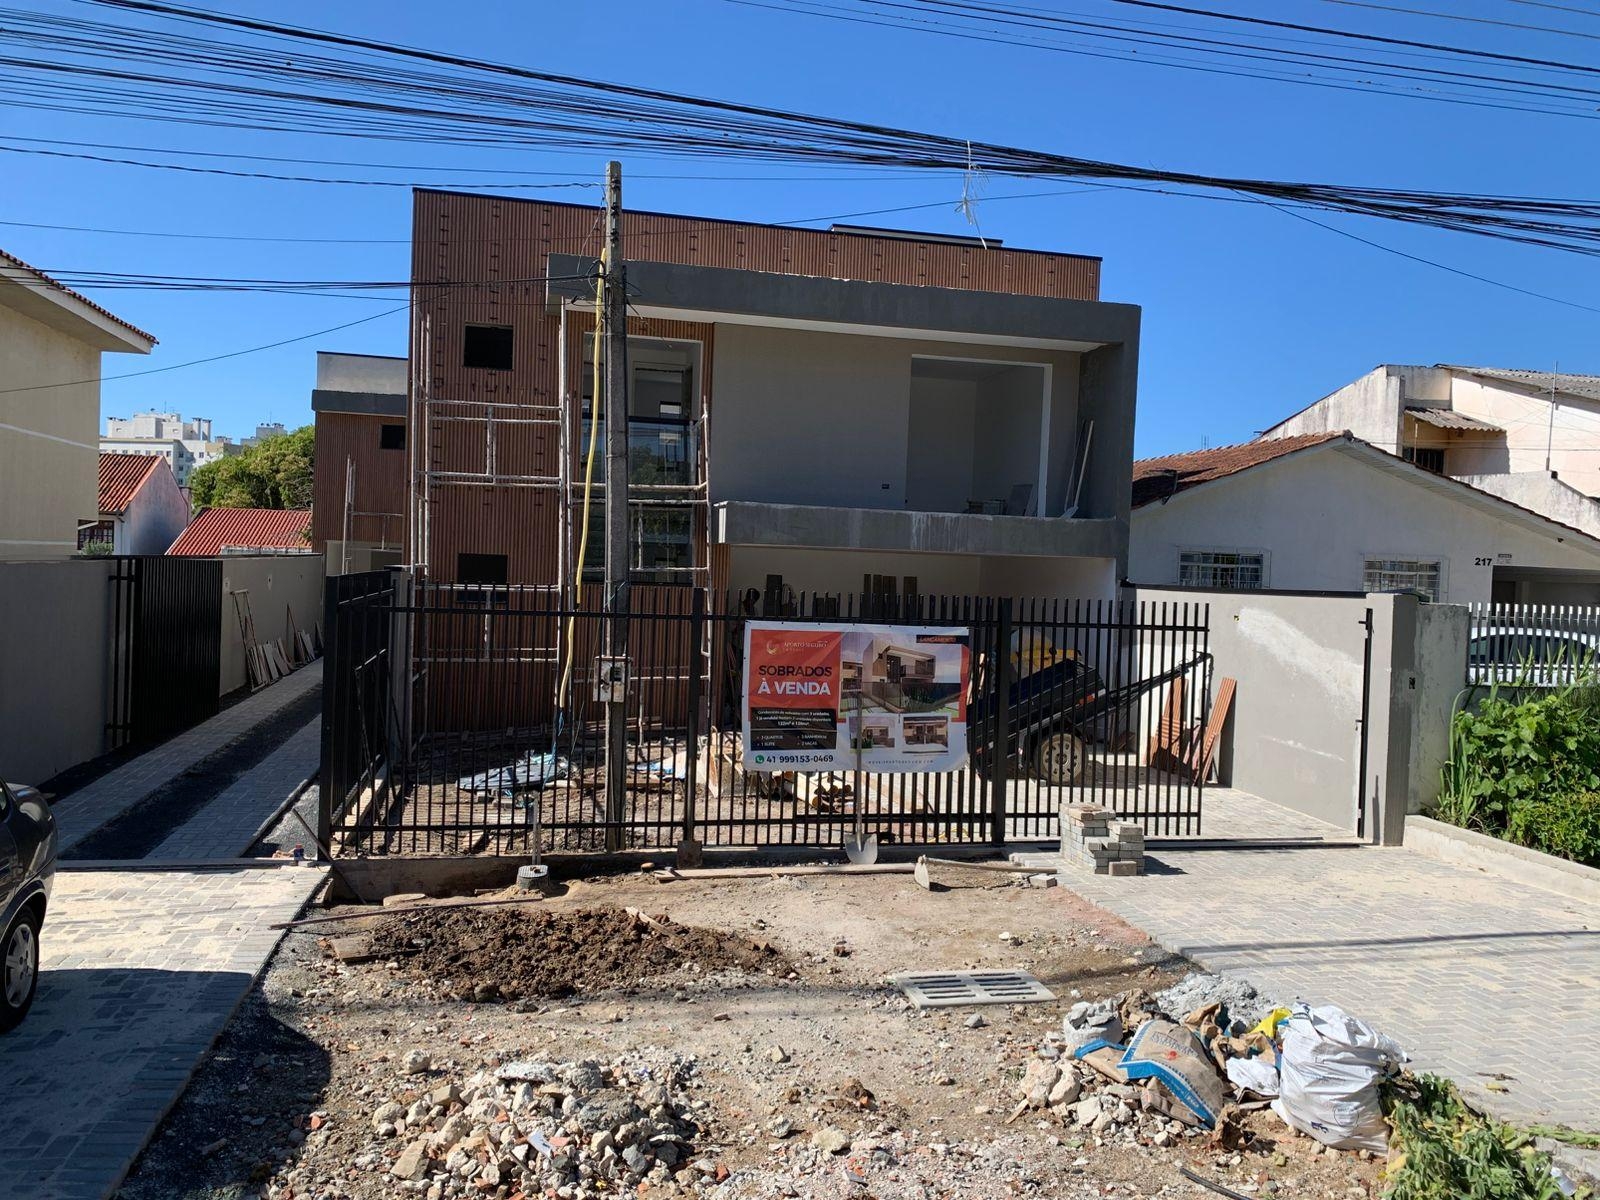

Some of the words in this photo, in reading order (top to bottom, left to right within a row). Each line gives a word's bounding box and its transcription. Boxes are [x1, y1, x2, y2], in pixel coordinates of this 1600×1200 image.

[1474, 557, 1493, 566] 217
[758, 665, 833, 677] SOBRADOS
[757, 677, 771, 695] À
[773, 680, 831, 695] VENDA
[766, 755, 777, 764] 41
[779, 754, 834, 764] 999153-0469
